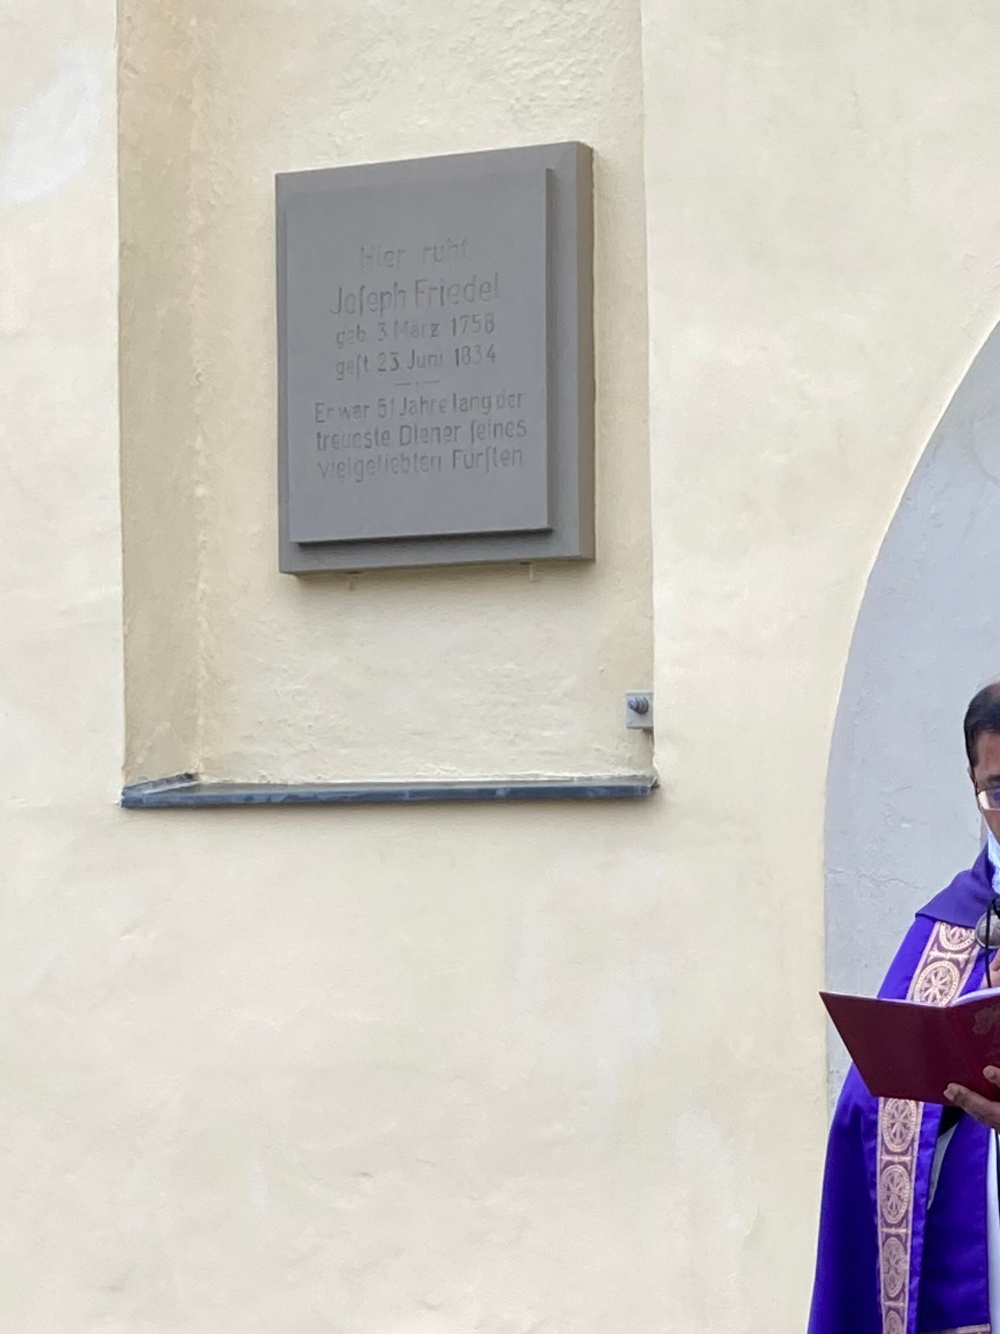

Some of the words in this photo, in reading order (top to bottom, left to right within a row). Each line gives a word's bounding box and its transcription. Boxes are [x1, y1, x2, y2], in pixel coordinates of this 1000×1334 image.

[414, 272, 500, 307] Friedel
[451, 313, 495, 337] 1758
[407, 350, 443, 369] Juni
[454, 344, 497, 367] 1834
[314, 402, 334, 423] Er
[338, 403, 370, 420] war
[399, 395, 447, 416] Jahre
[399, 423, 462, 446] Diener
